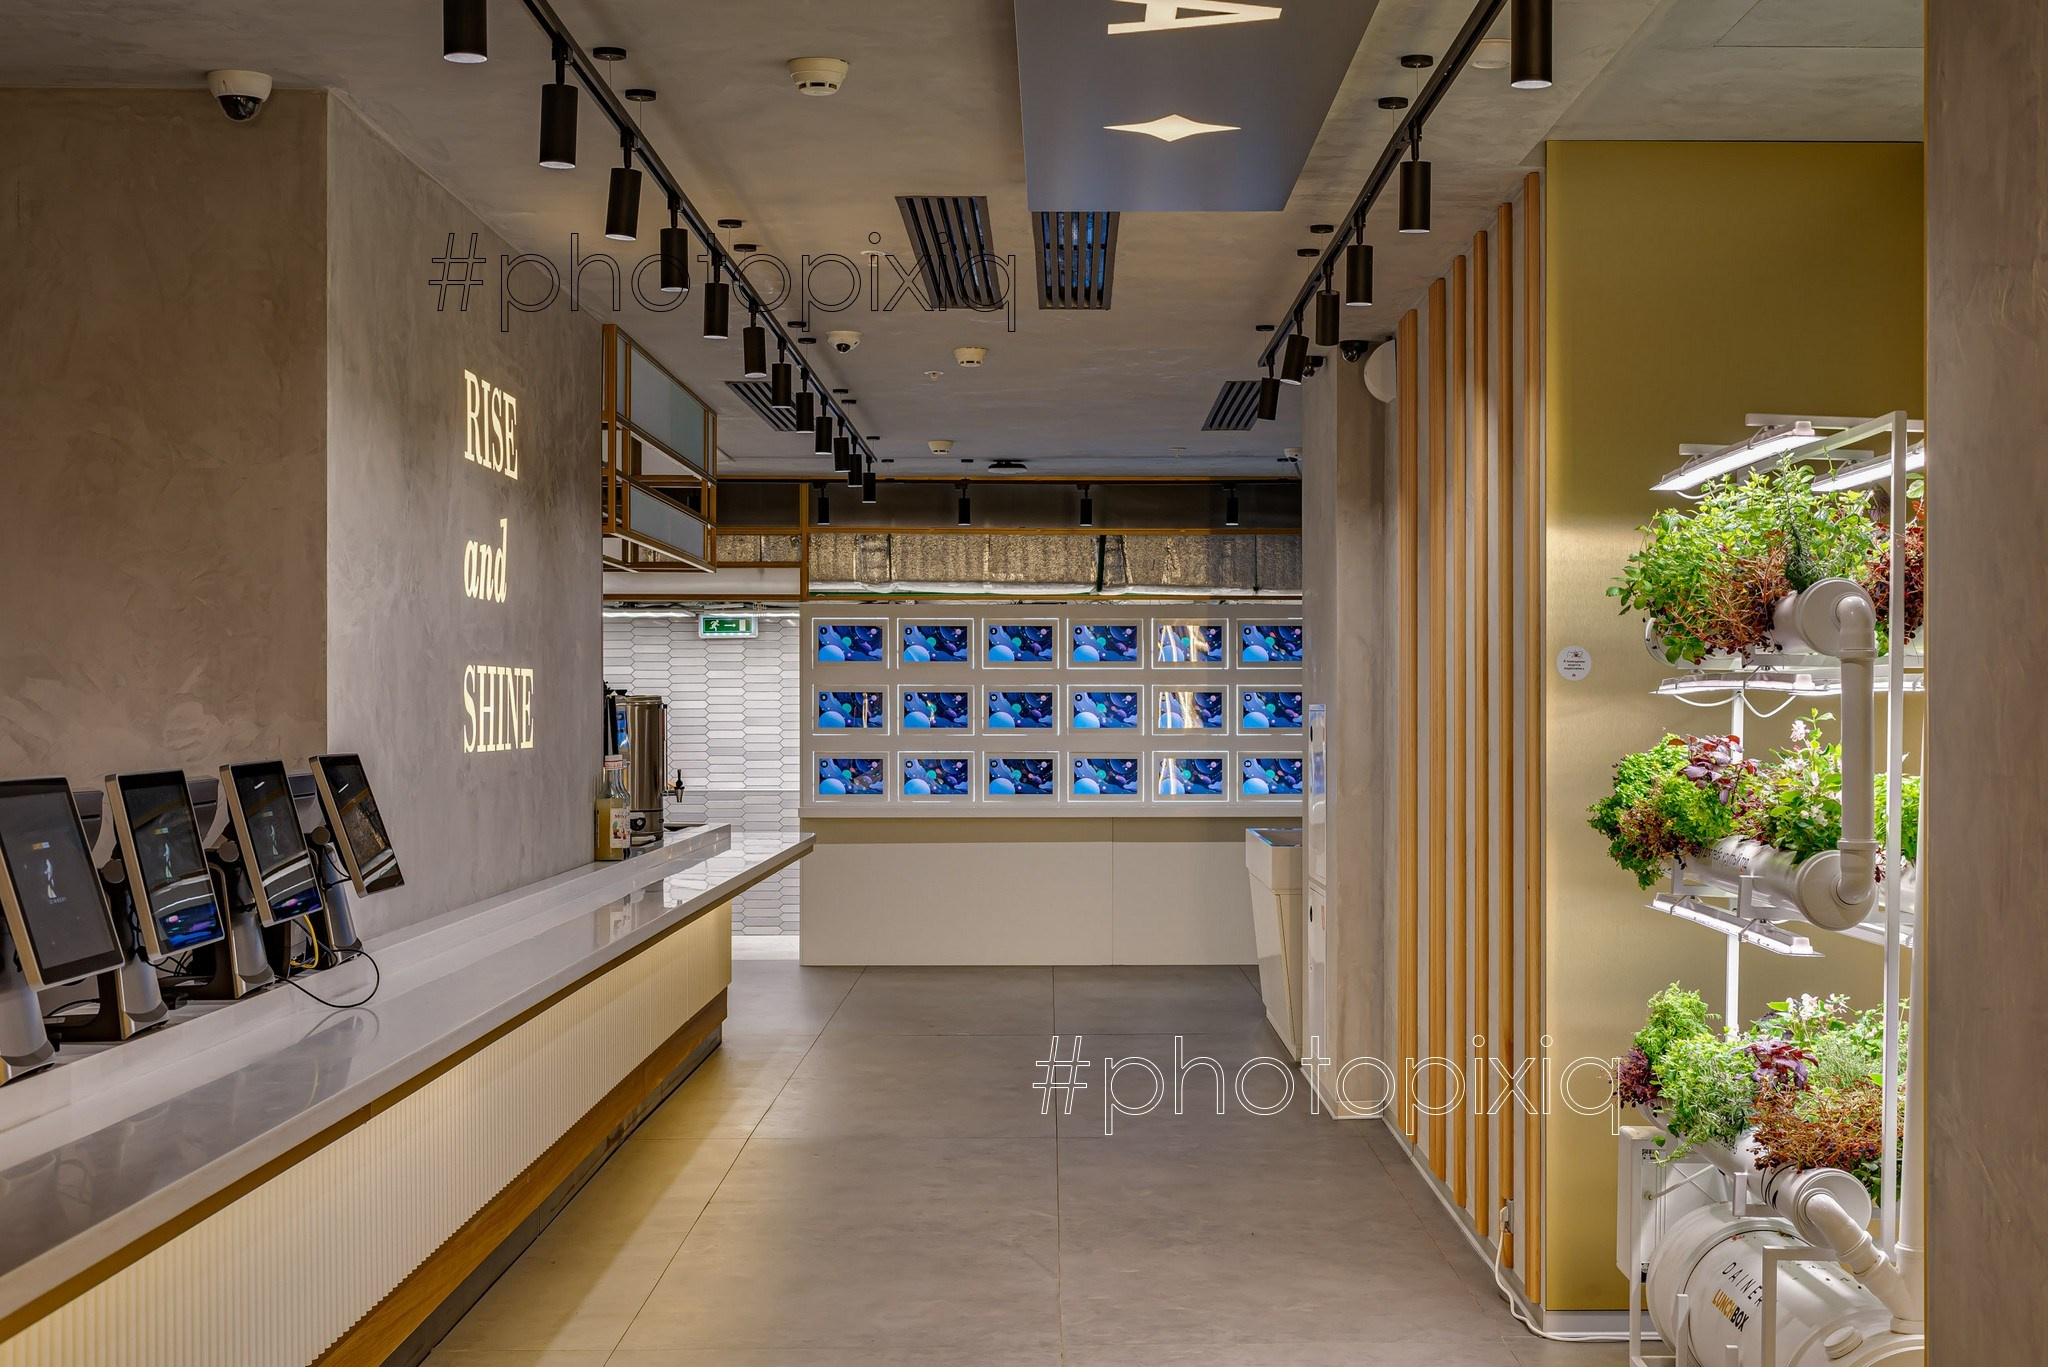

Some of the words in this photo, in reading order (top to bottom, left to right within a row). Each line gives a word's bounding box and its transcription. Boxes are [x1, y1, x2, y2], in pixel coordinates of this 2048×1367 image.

[464, 369, 519, 480] RISE
[463, 518, 508, 603] and
[463, 664, 534, 753] SHINE
[1712, 1289, 1749, 1331] LUNCHBOX
